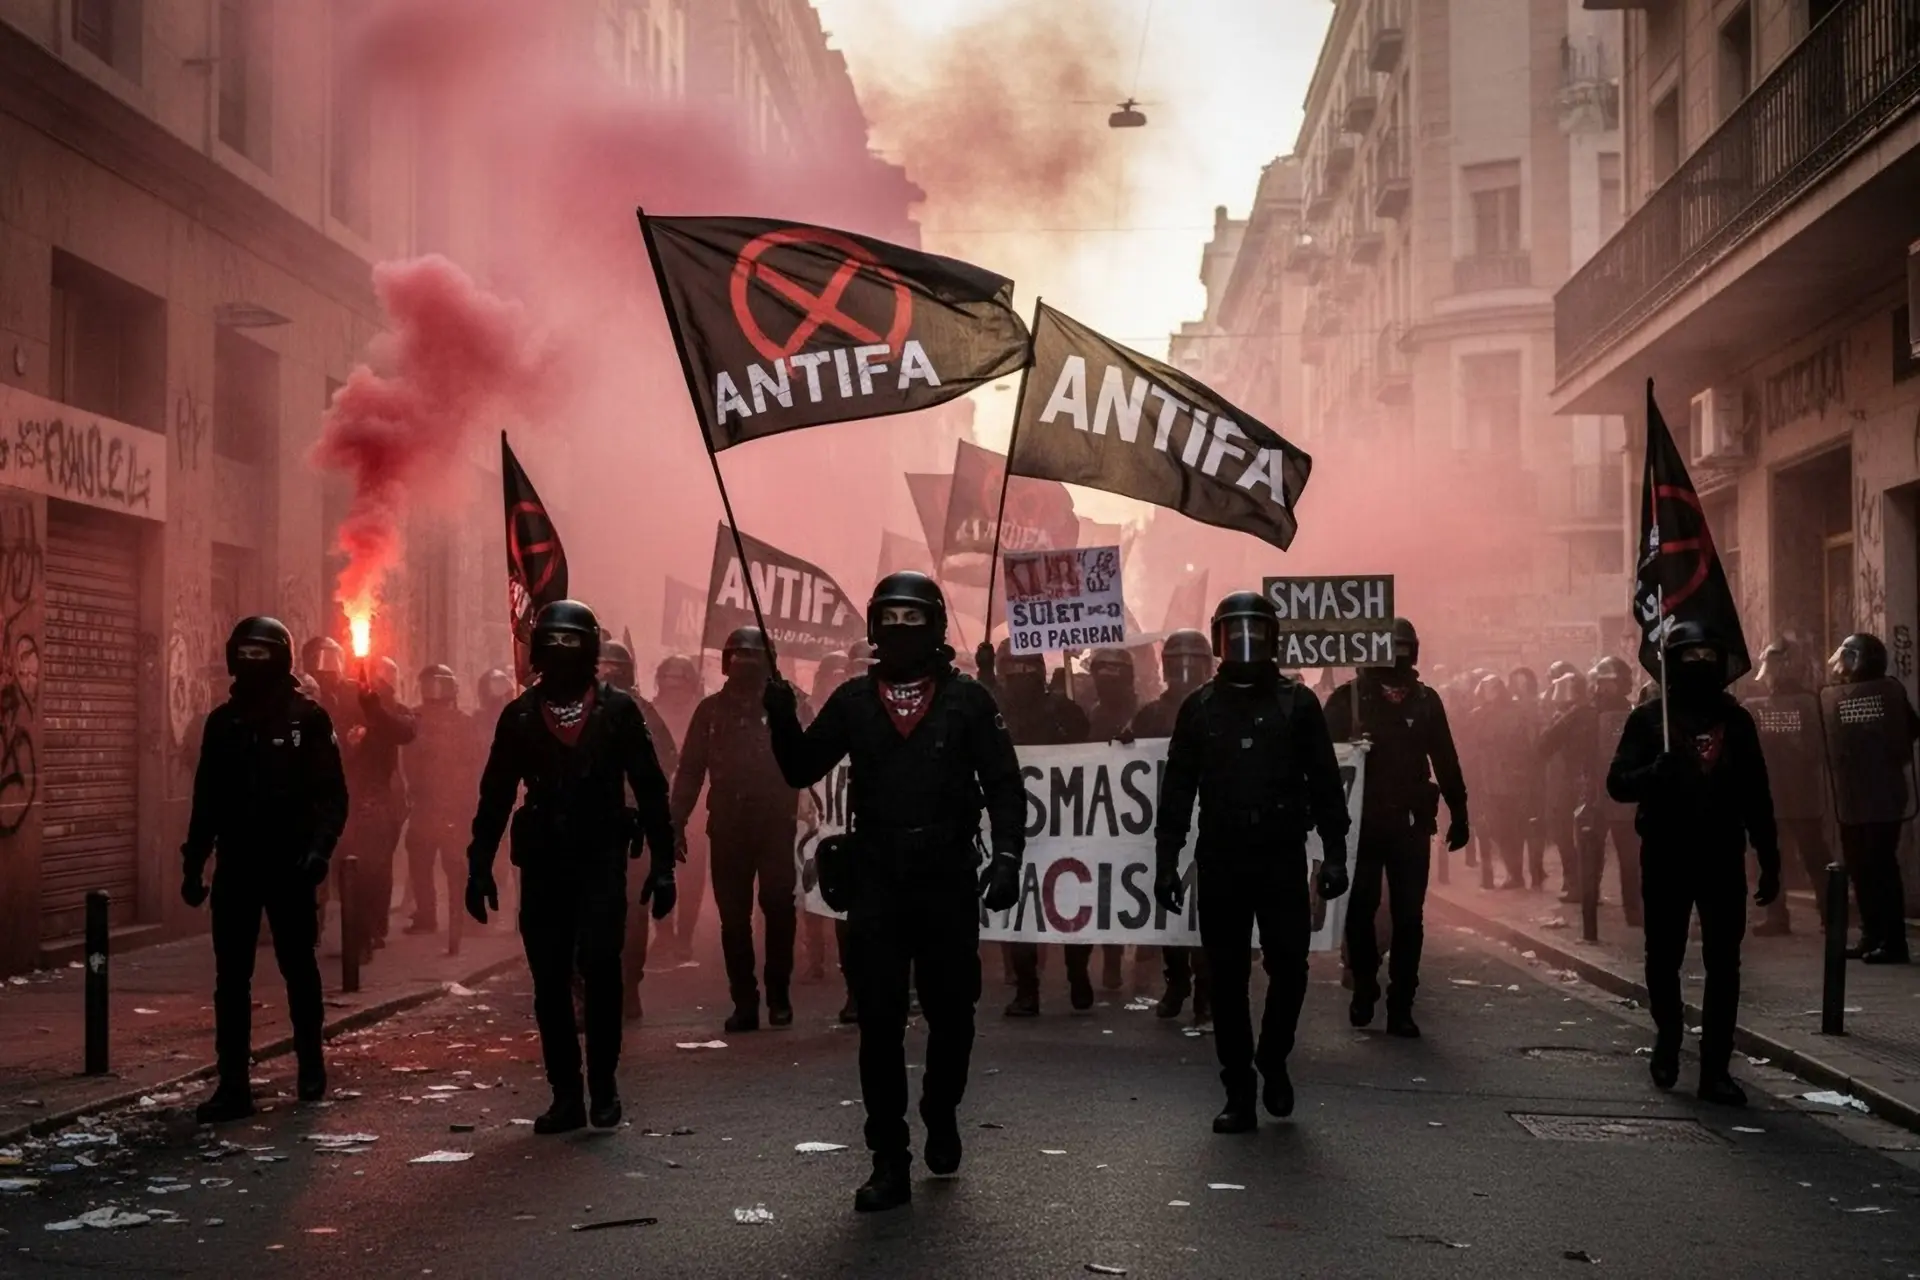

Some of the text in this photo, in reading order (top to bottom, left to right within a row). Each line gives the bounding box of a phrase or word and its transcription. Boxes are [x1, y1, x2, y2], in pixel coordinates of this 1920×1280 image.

[716, 340, 941, 425] ANTIFA
[1039, 355, 1286, 507] ANTIFA
[1270, 580, 1385, 620] SMASH
[1020, 759, 1168, 837] SMAS
